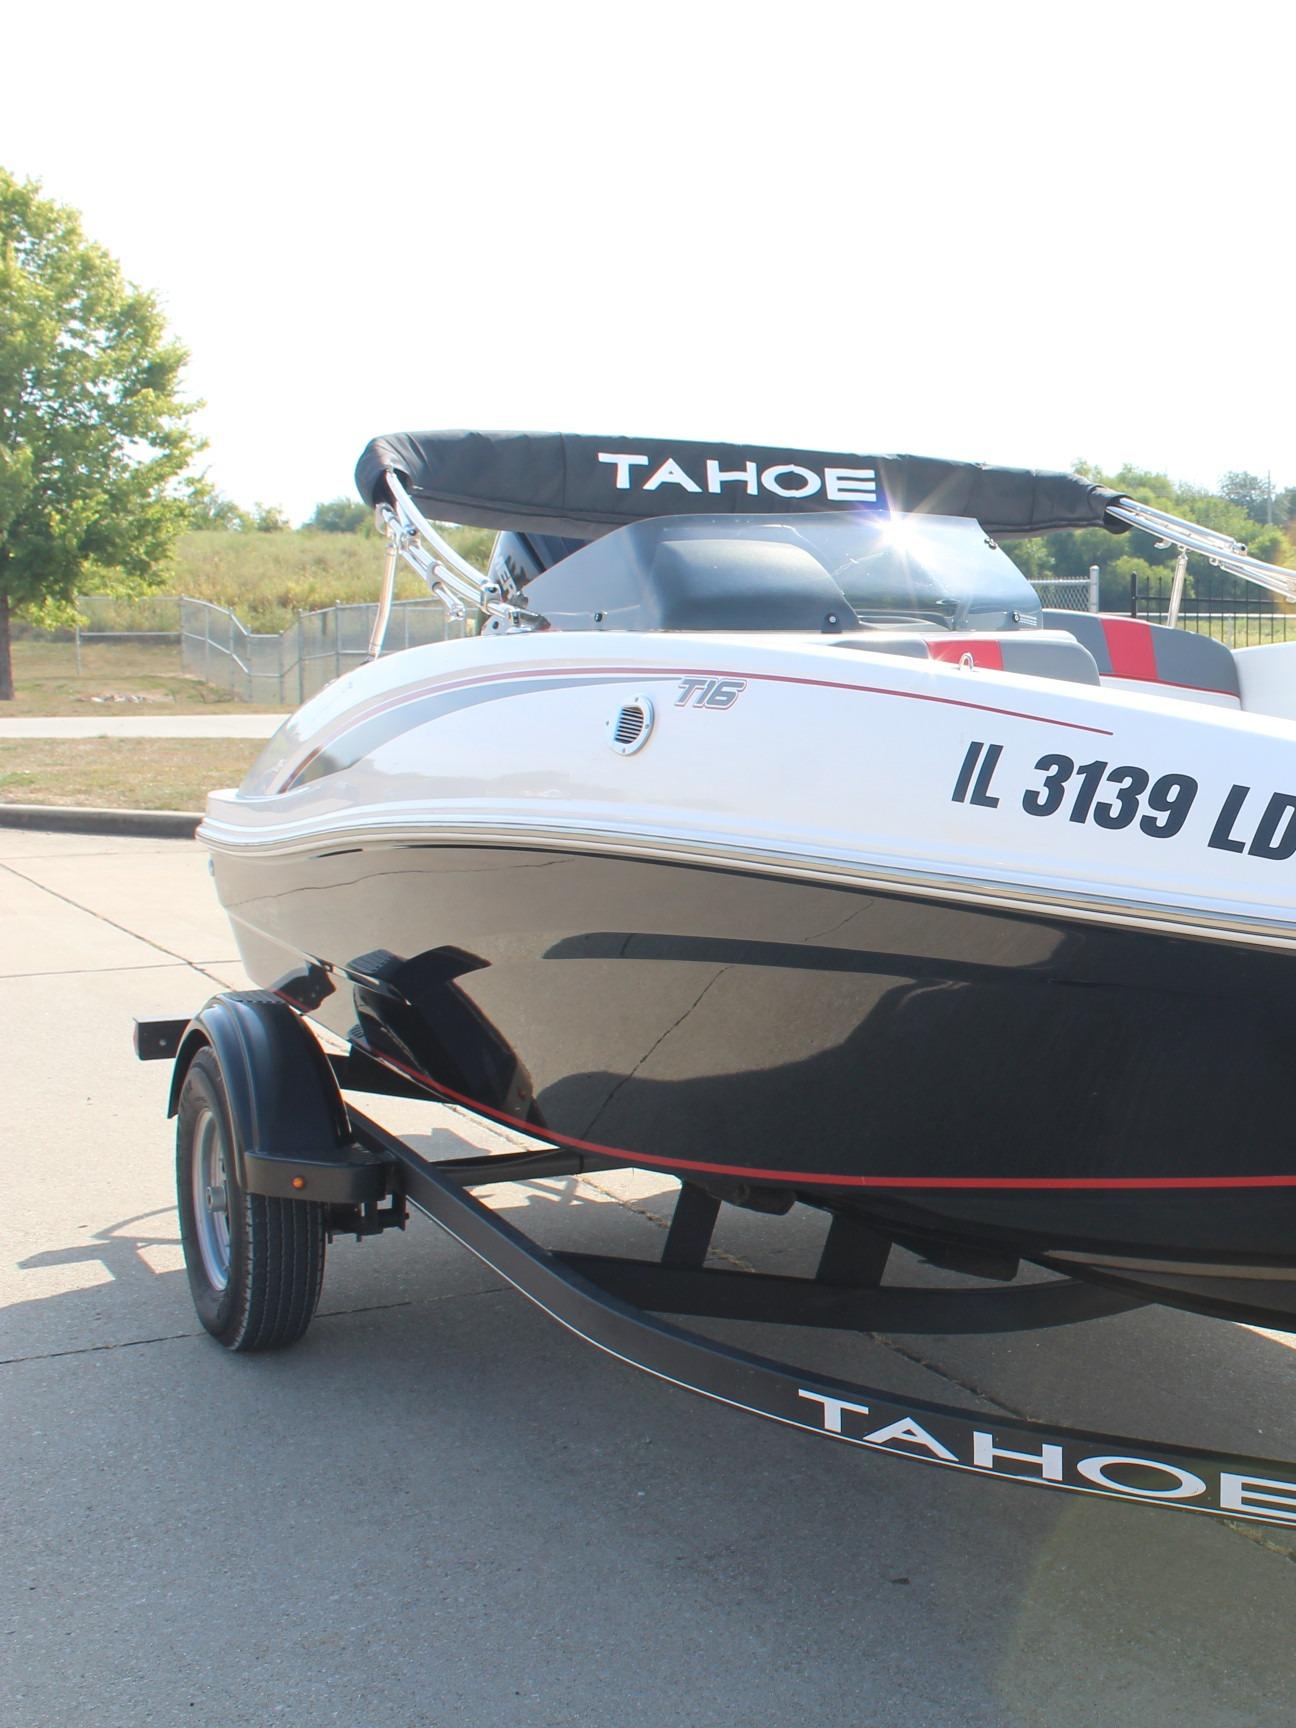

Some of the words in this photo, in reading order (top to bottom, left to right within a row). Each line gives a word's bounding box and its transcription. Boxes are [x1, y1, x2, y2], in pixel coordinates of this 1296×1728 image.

[597, 452, 877, 502] TAHOE
[674, 676, 747, 710] T16
[951, 741, 1004, 809] IL
[1022, 753, 1198, 838] 3139
